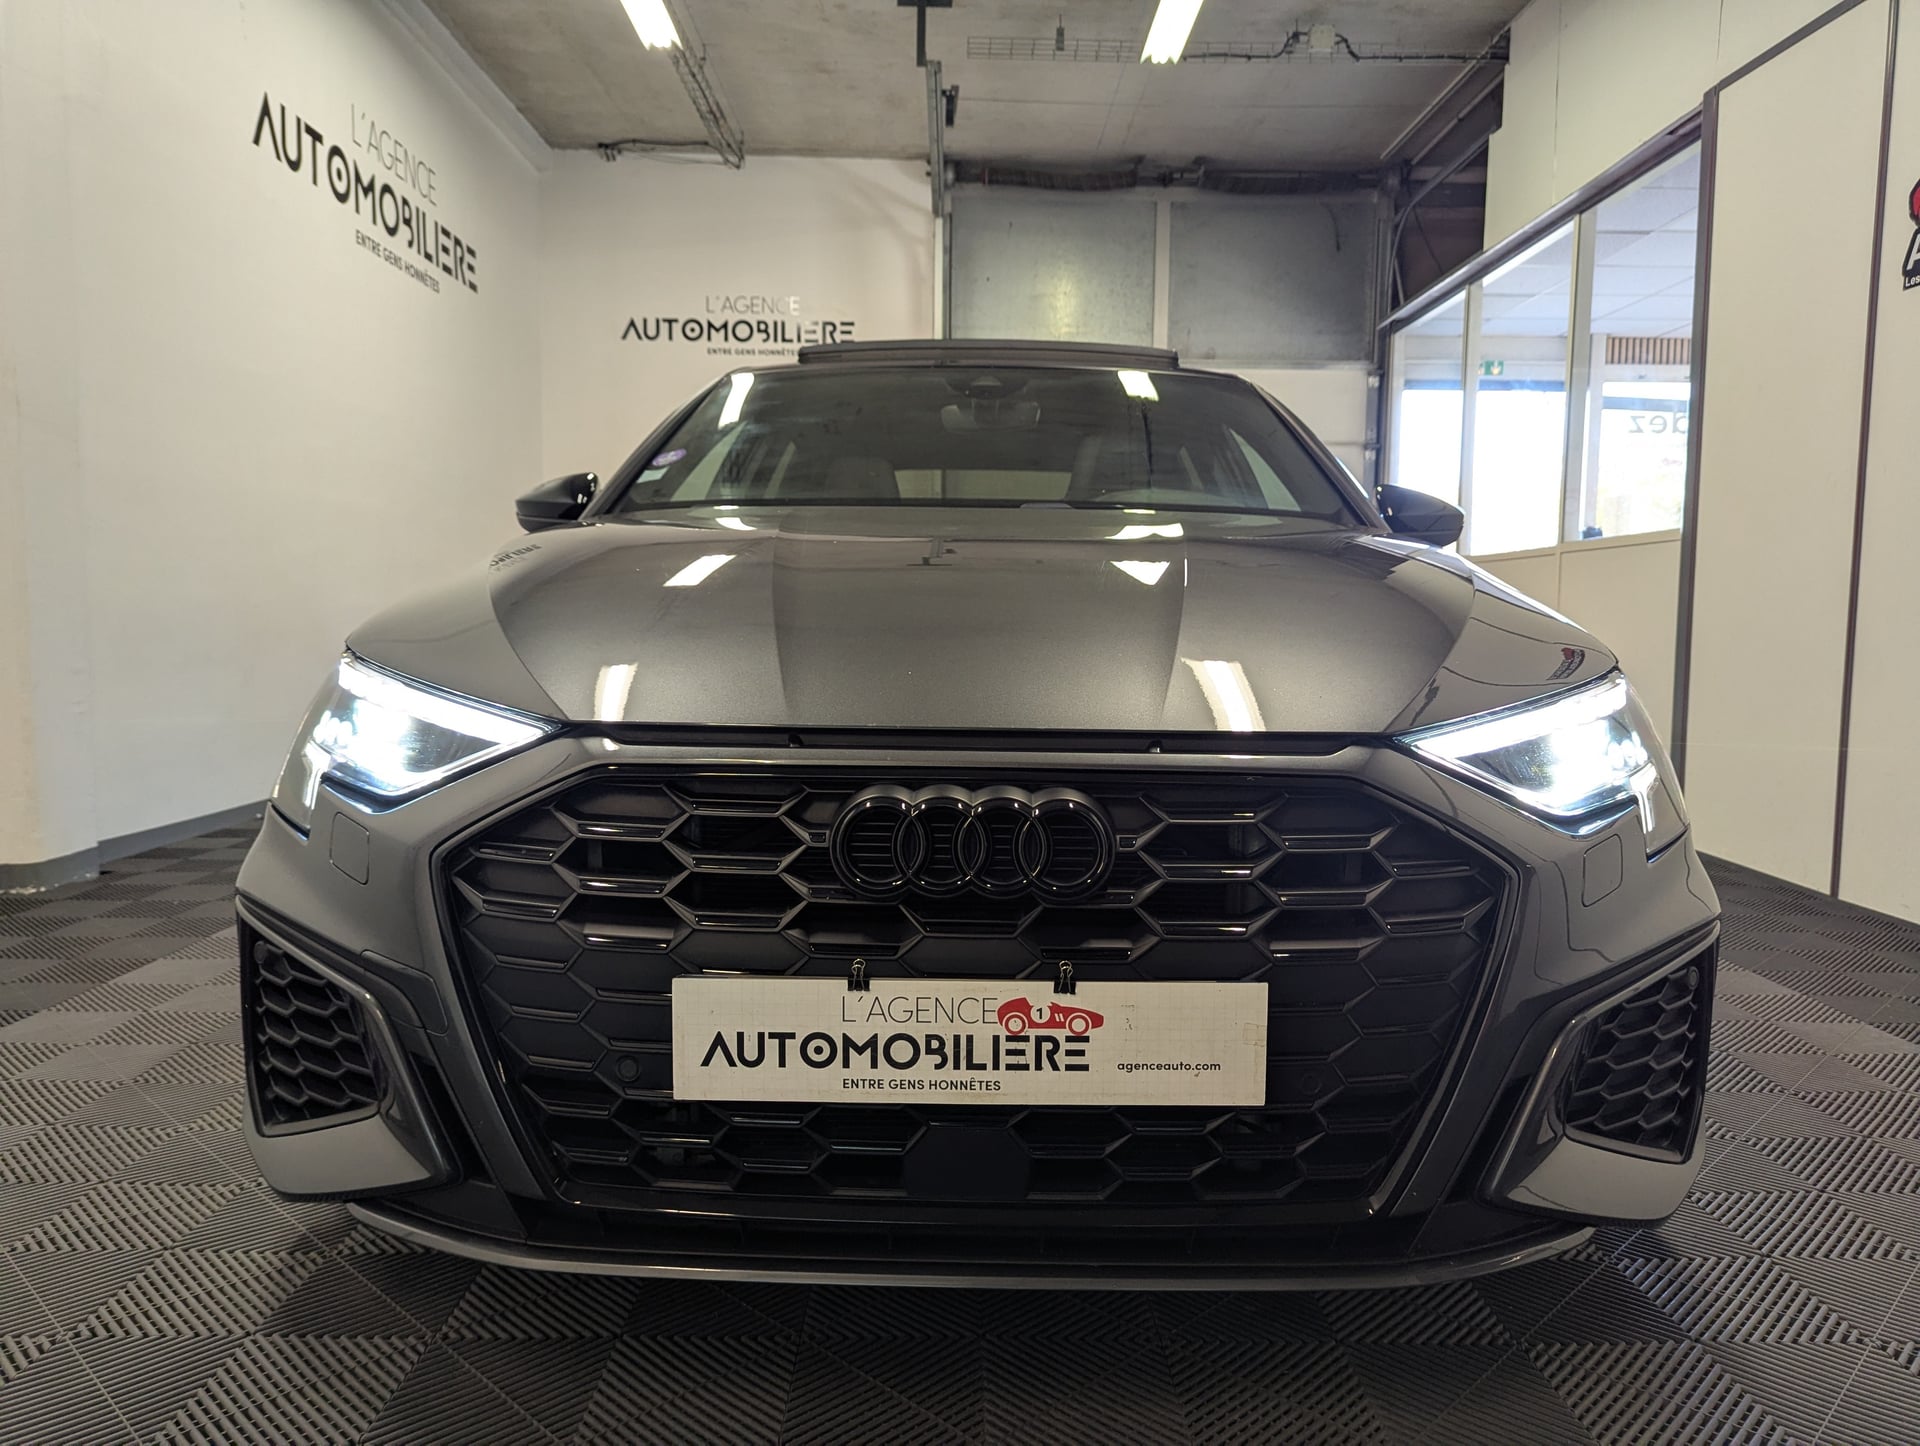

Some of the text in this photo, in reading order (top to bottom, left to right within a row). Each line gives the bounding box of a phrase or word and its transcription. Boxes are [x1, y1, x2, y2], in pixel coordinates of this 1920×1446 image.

[351, 103, 437, 207] L'AGENCE
[356, 229, 381, 258] ENTRE
[384, 247, 403, 271] GENS
[707, 346, 799, 357] ENTRE GENS HONNÊTE
[842, 996, 999, 1024] L'AGENCE
[1036, 1007, 1043, 1020] 1
[700, 1031, 1090, 1072] AUTOMOBILIERE
[1117, 1061, 1222, 1074] agenceauto.com
[842, 1077, 1001, 1092] ENTRE GENS HONNÊTES
